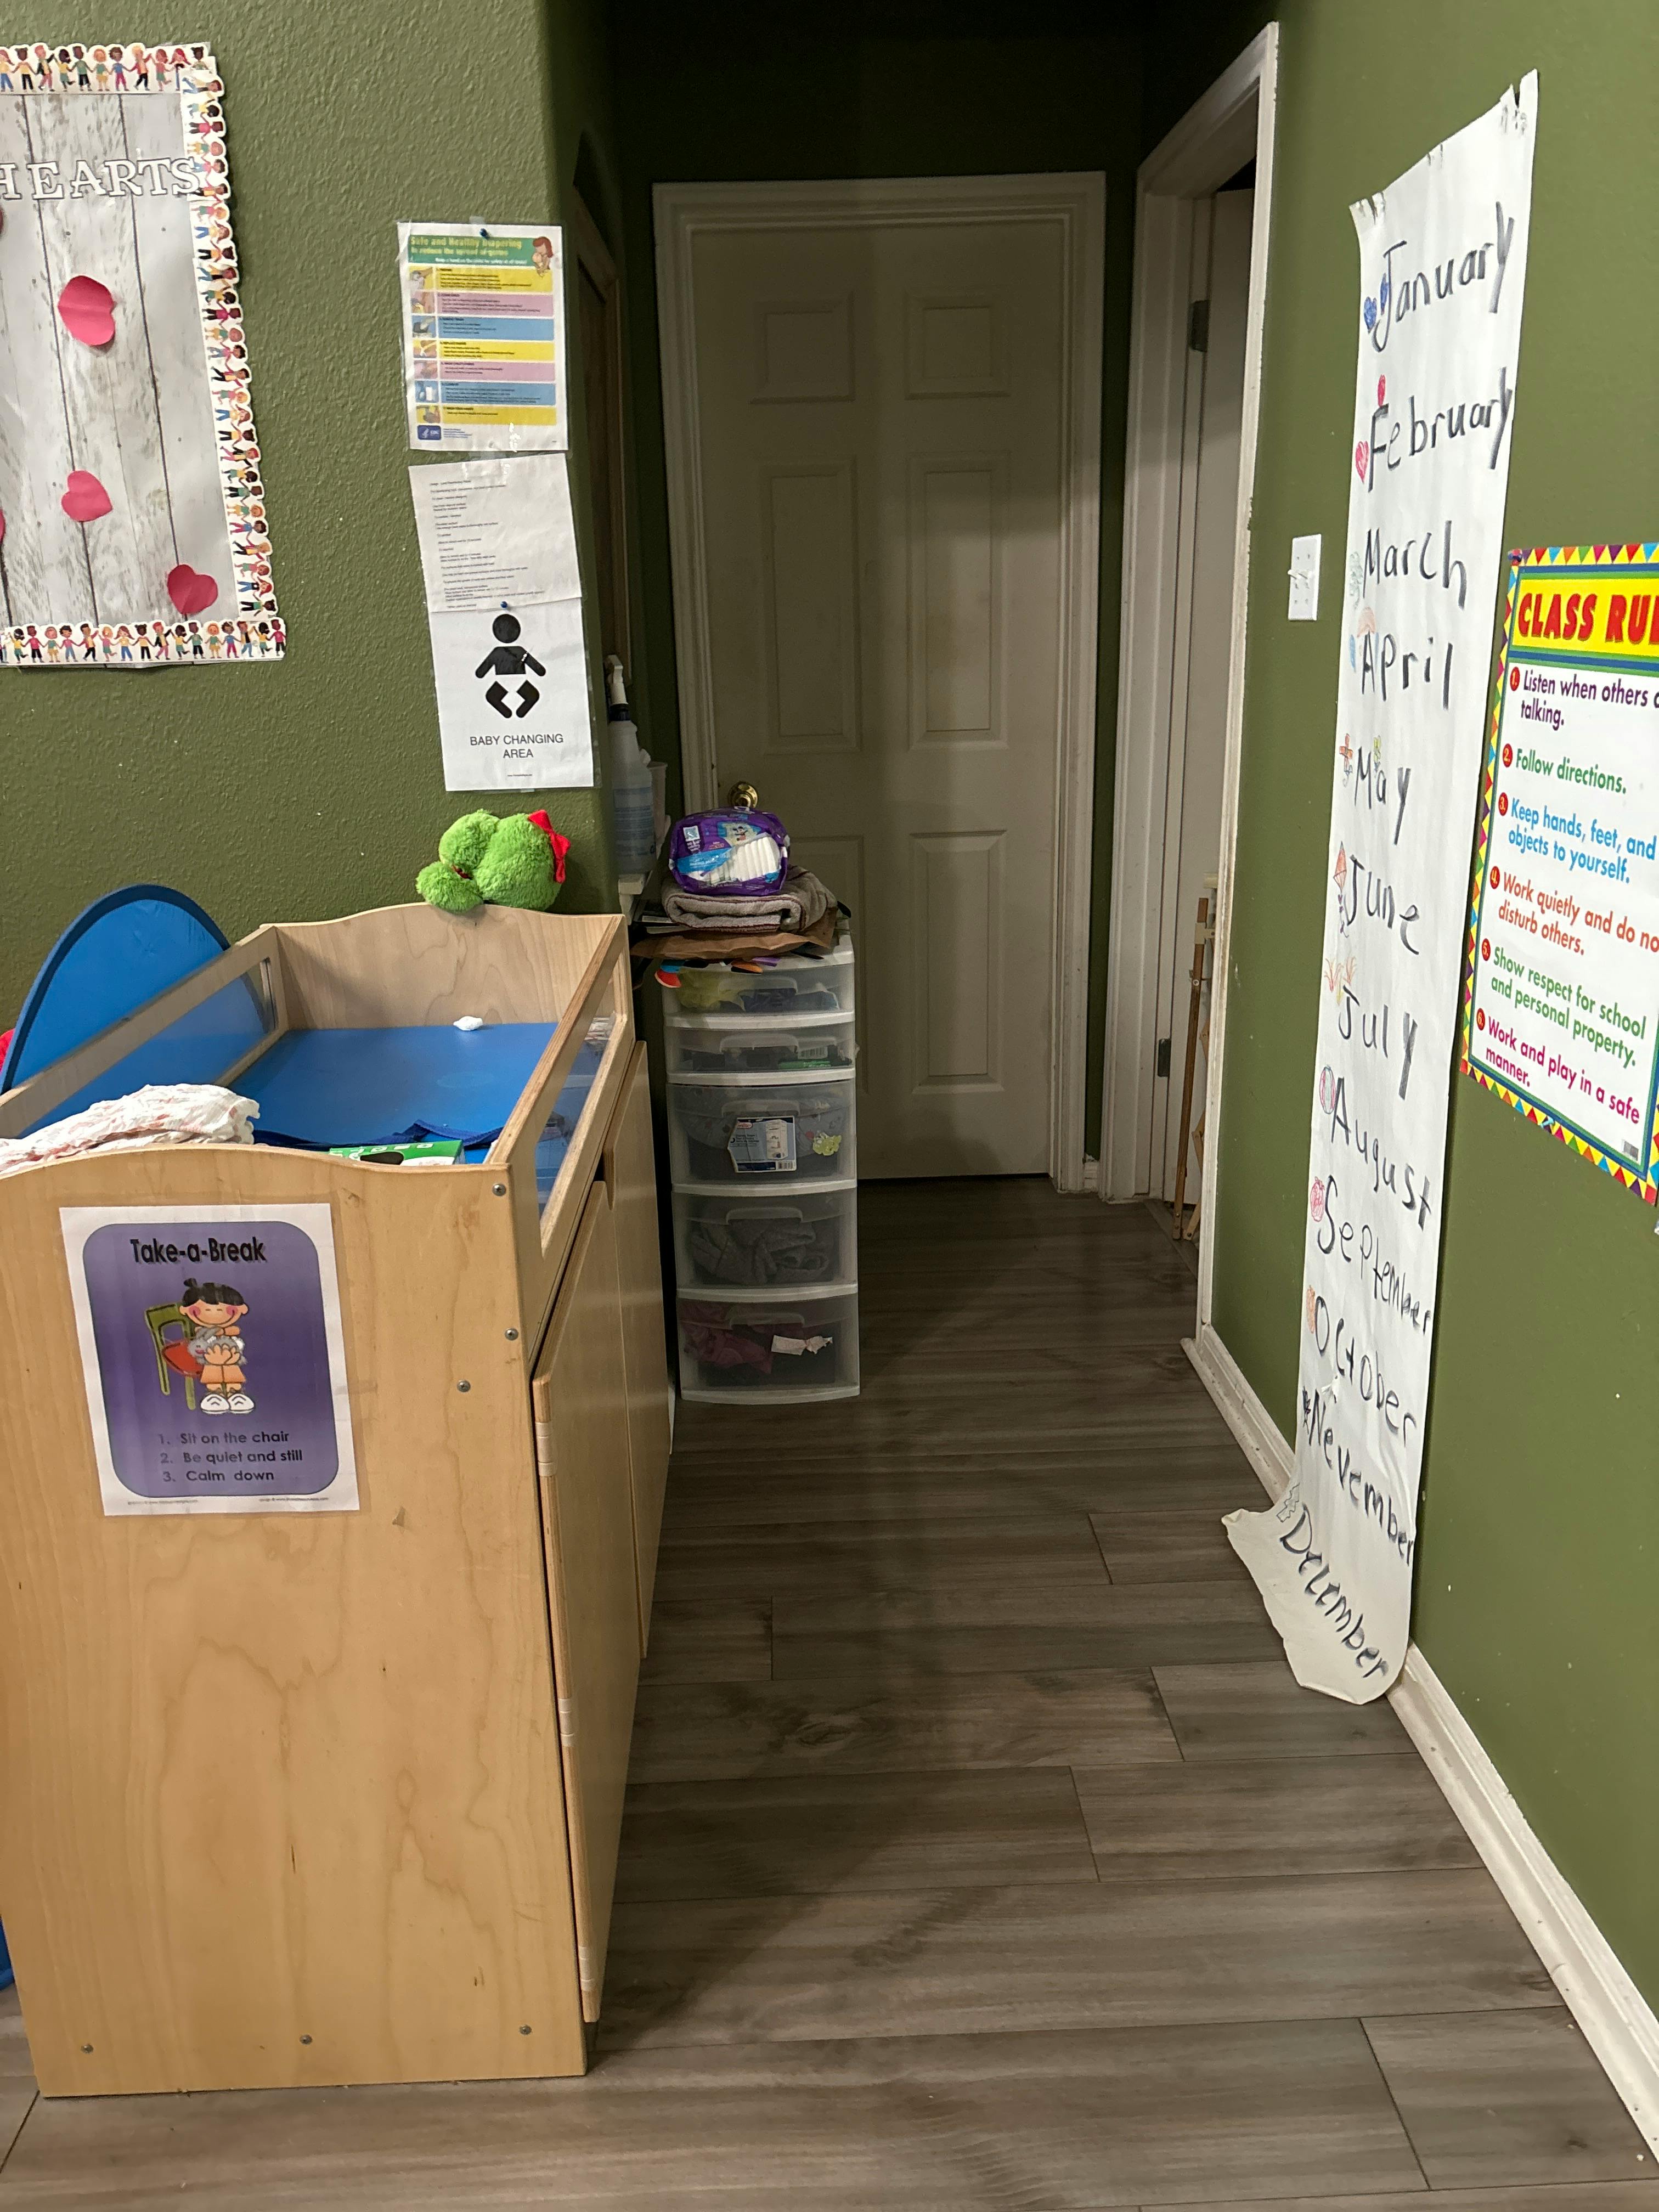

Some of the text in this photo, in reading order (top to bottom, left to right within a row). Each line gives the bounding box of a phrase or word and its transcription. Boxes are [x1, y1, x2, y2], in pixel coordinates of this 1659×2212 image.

[0, 156, 201, 201] HEARTS
[1372, 201, 1514, 353] January
[1368, 367, 1513, 493] February
[1363, 520, 1466, 610] March
[1517, 593, 1598, 641] CLASS
[1521, 699, 1564, 731] talking.
[1523, 670, 1555, 695] Listen
[1561, 674, 1596, 701] when
[1602, 678, 1649, 708] others
[470, 733, 563, 746] BABY CHANGING
[503, 749, 533, 759] AREA
[1355, 746, 1411, 845] May
[1516, 749, 1554, 776] Follow
[1557, 757, 1627, 794] directions.
[1508, 824, 1630, 884] objects to yourself.
[1511, 797, 1539, 830] Keep
[1543, 805, 1587, 843] hands,
[1590, 819, 1621, 853] feet,
[1627, 835, 1657, 860] and
[1344, 854, 1420, 956] June
[1498, 899, 1584, 956] disturb others.
[1504, 872, 1534, 902] Work
[1537, 890, 1580, 926] quietly
[1585, 910, 1613, 934] and
[1616, 916, 1635, 943] do
[1491, 975, 1635, 1068] and personal property.
[1493, 945, 1525, 976] Show
[1528, 964, 1572, 1002] respect
[1576, 985, 1595, 1012] for
[1599, 1001, 1646, 1040] school
[1339, 985, 1418, 1101] July
[1486, 1047, 1531, 1087] manner.
[1488, 1015, 1517, 1049] Work
[1520, 1036, 1545, 1066] and
[1548, 1054, 1576, 1088] play
[1580, 1071, 1592, 1093] in
[1596, 1086, 1605, 1103] a
[1609, 1095, 1640, 1125] safe
[1331, 1077, 1431, 1231] August
[131, 1237, 267, 1263] Take-a-Break
[1318, 1175, 1431, 1335] September
[1314, 1296, 1416, 1448] October
[159, 1431, 289, 1444] 1. Sit on the chair
[161, 1449, 303, 1465] 2. Be quiet and still
[163, 1469, 275, 1482] 3. Calm down
